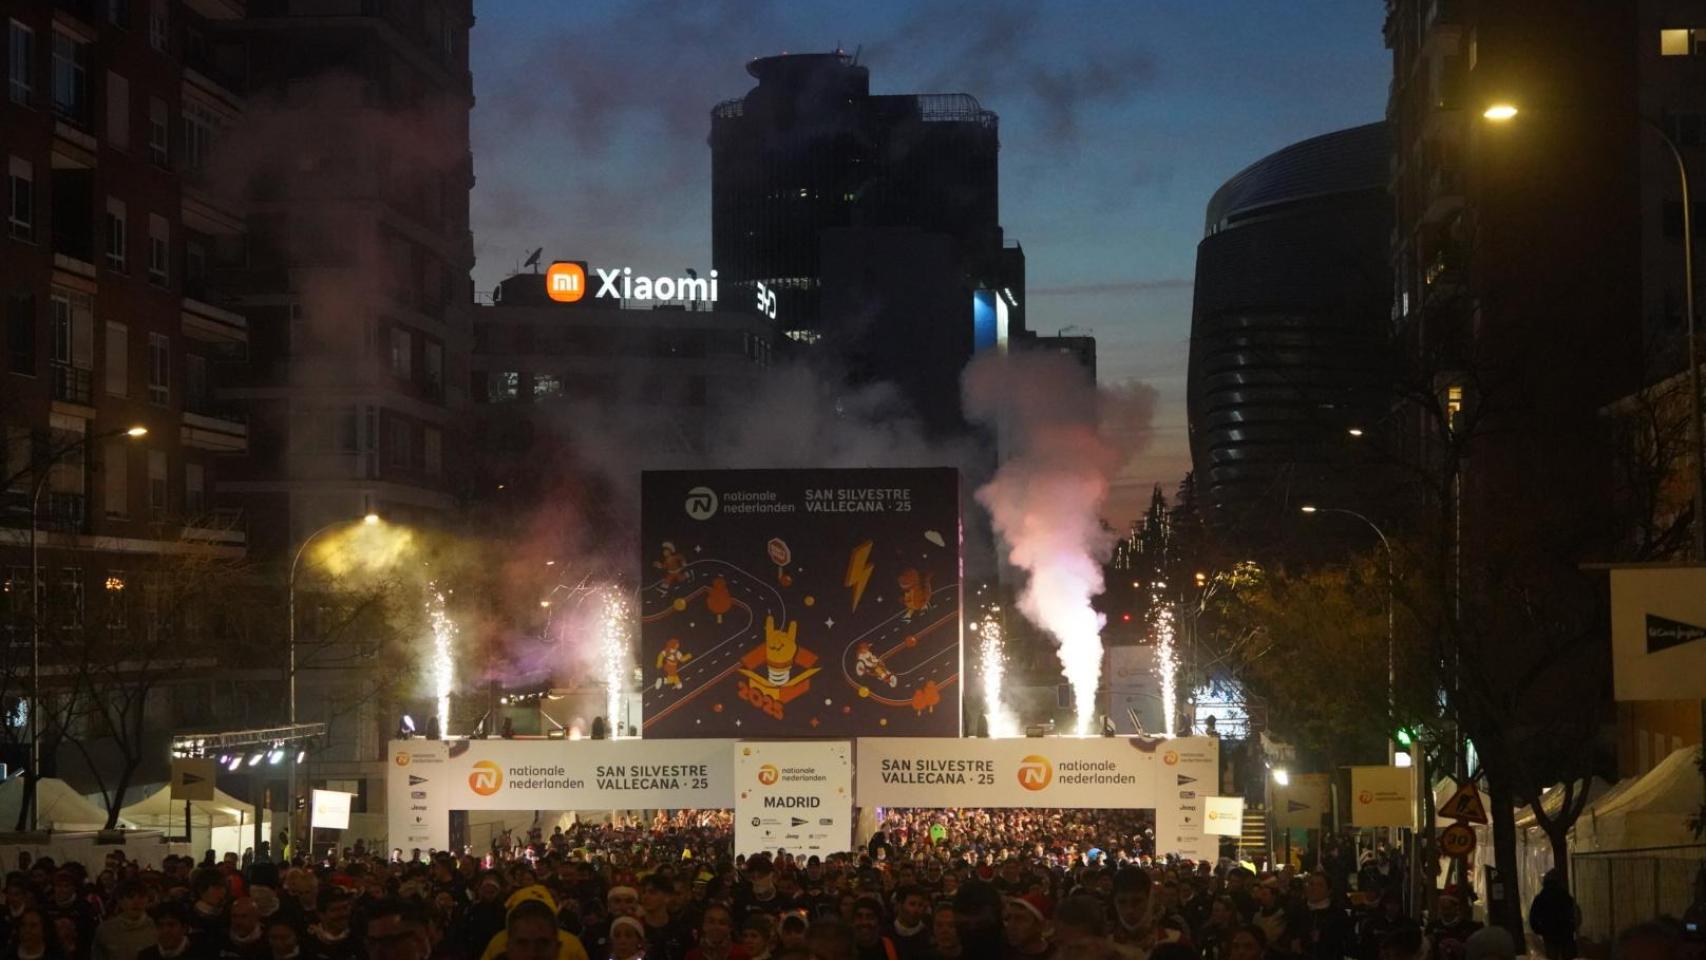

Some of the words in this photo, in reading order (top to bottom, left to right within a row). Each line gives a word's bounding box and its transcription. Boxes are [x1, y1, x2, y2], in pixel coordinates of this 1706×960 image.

[596, 267, 719, 302] Xiaomi
[723, 490, 777, 501] nationale
[805, 489, 833, 501] SAN
[837, 488, 911, 500] SILVESTRE
[723, 501, 795, 513] nederlanden
[805, 501, 884, 512] VALLECANA
[895, 501, 912, 512] 25
[738, 680, 785, 720] 2025
[509, 765, 566, 777] nationale
[596, 765, 626, 777] SAN
[630, 764, 709, 777] SILVESTRE
[881, 759, 911, 772] SAN
[916, 759, 993, 772] SILVESTRE
[1059, 760, 1116, 772] nationale
[509, 777, 585, 789] nederlanden
[596, 777, 680, 790] VALLECANA
[691, 777, 710, 790] 25
[781, 774, 827, 782] nederlanden
[881, 772, 966, 784] VALLECANA
[977, 773, 995, 785] 25
[1059, 772, 1136, 785] nederlanden
[764, 796, 821, 808] MADRID
